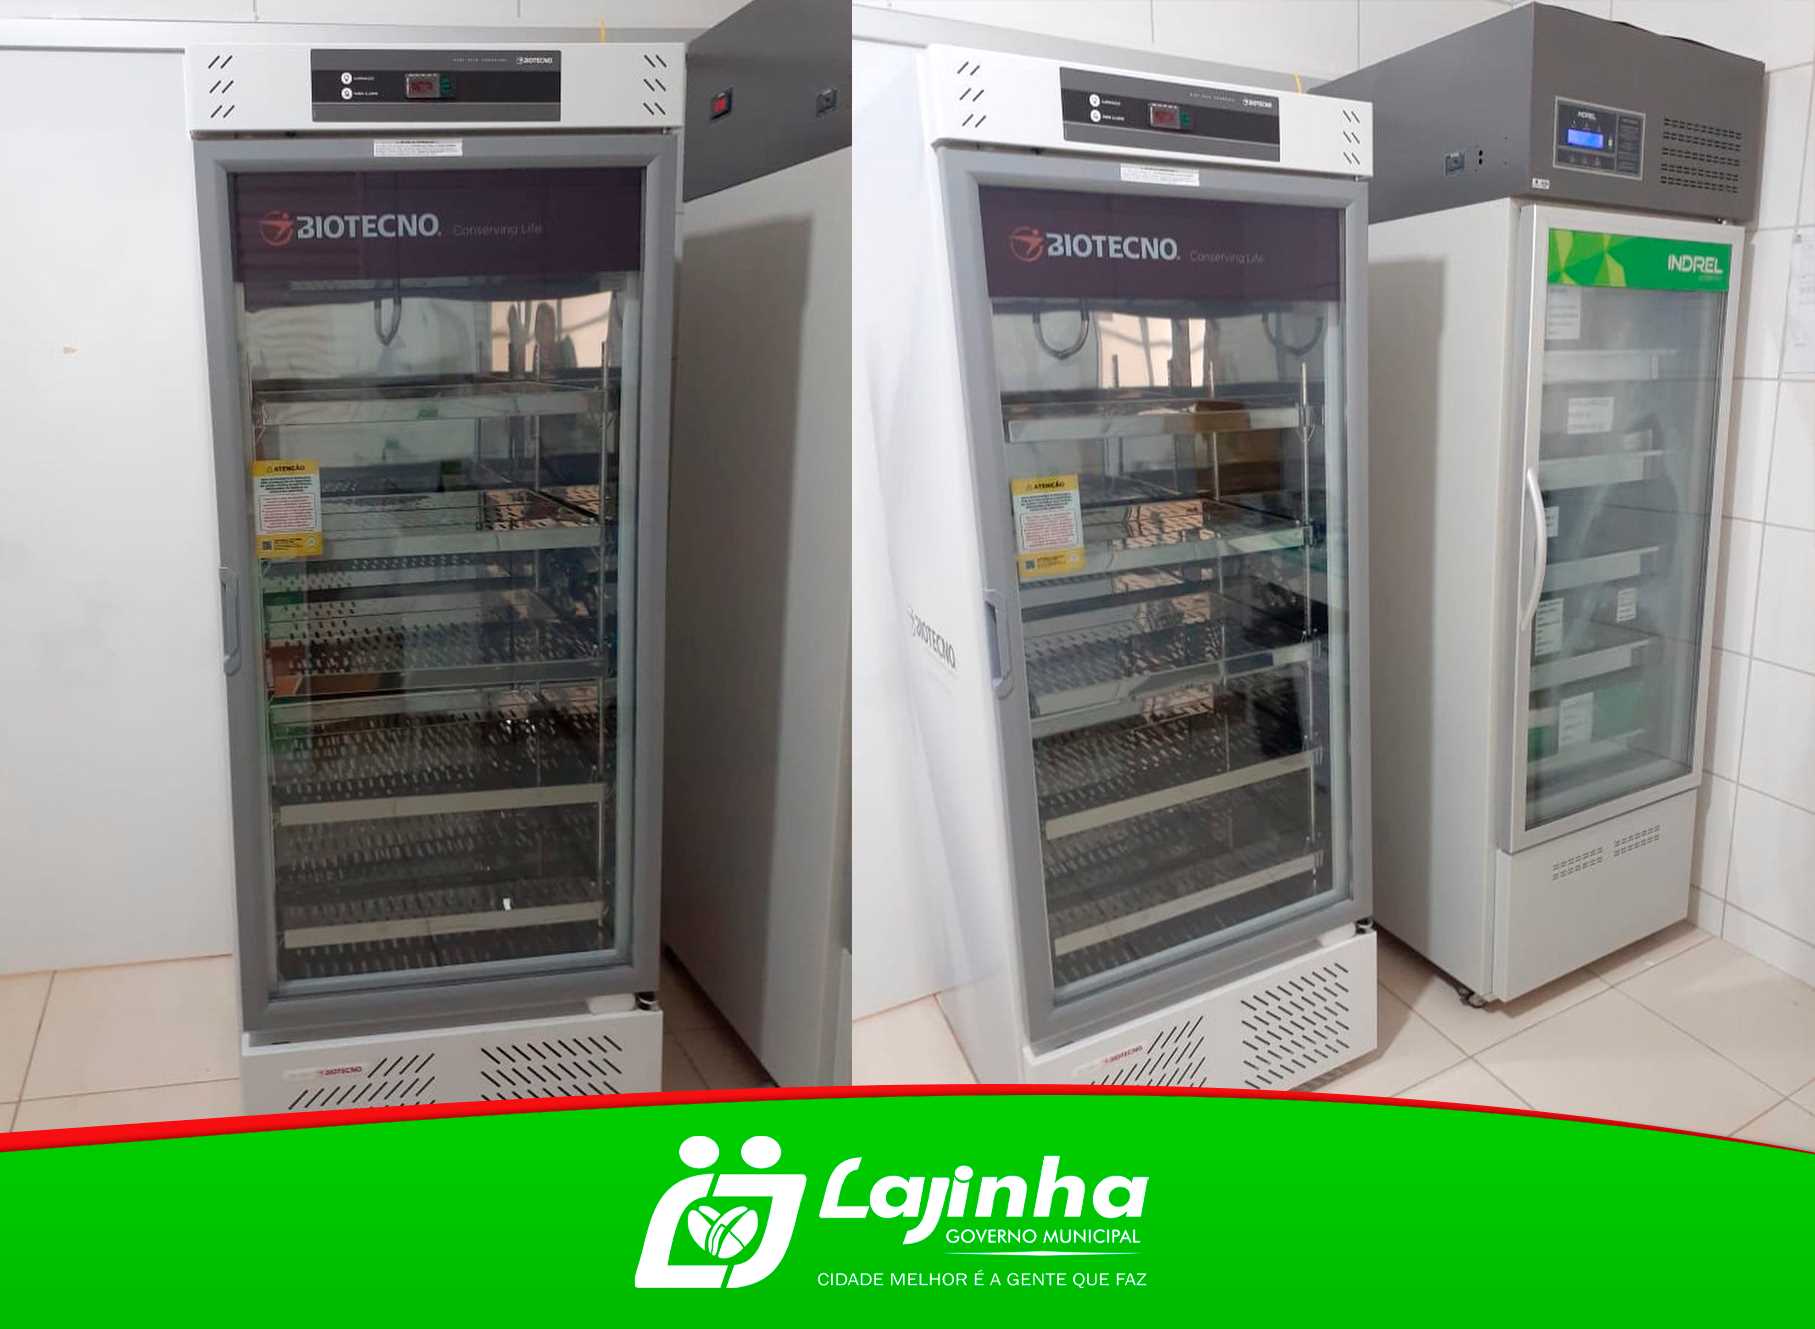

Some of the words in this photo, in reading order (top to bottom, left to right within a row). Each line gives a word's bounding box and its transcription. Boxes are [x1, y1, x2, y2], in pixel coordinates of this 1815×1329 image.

[296, 213, 441, 239] BIOTECNO
[1046, 233, 1180, 261] BIOTECNO
[1668, 254, 1723, 274] INDREL
